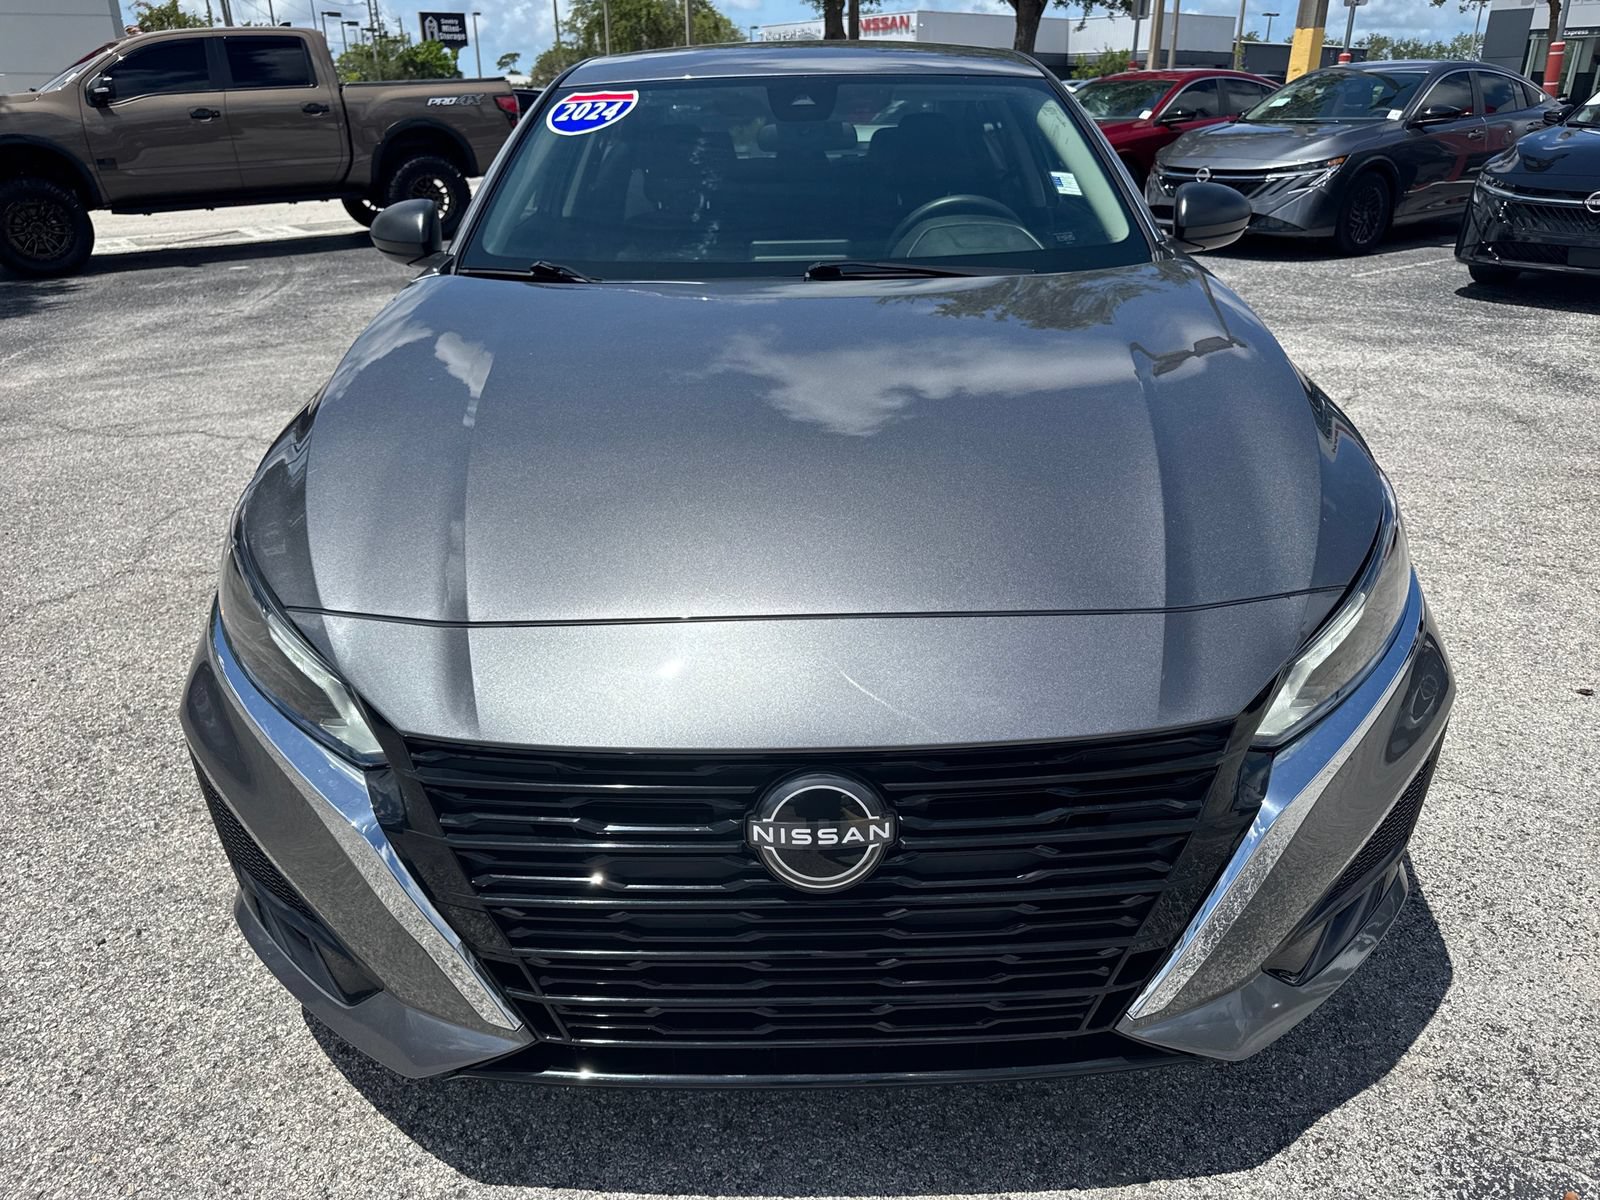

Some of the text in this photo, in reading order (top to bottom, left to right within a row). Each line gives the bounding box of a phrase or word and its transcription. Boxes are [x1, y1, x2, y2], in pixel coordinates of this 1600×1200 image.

[439, 32, 466, 41] Storage
[554, 102, 624, 121] 2024
[752, 822, 890, 845] NISSAN
